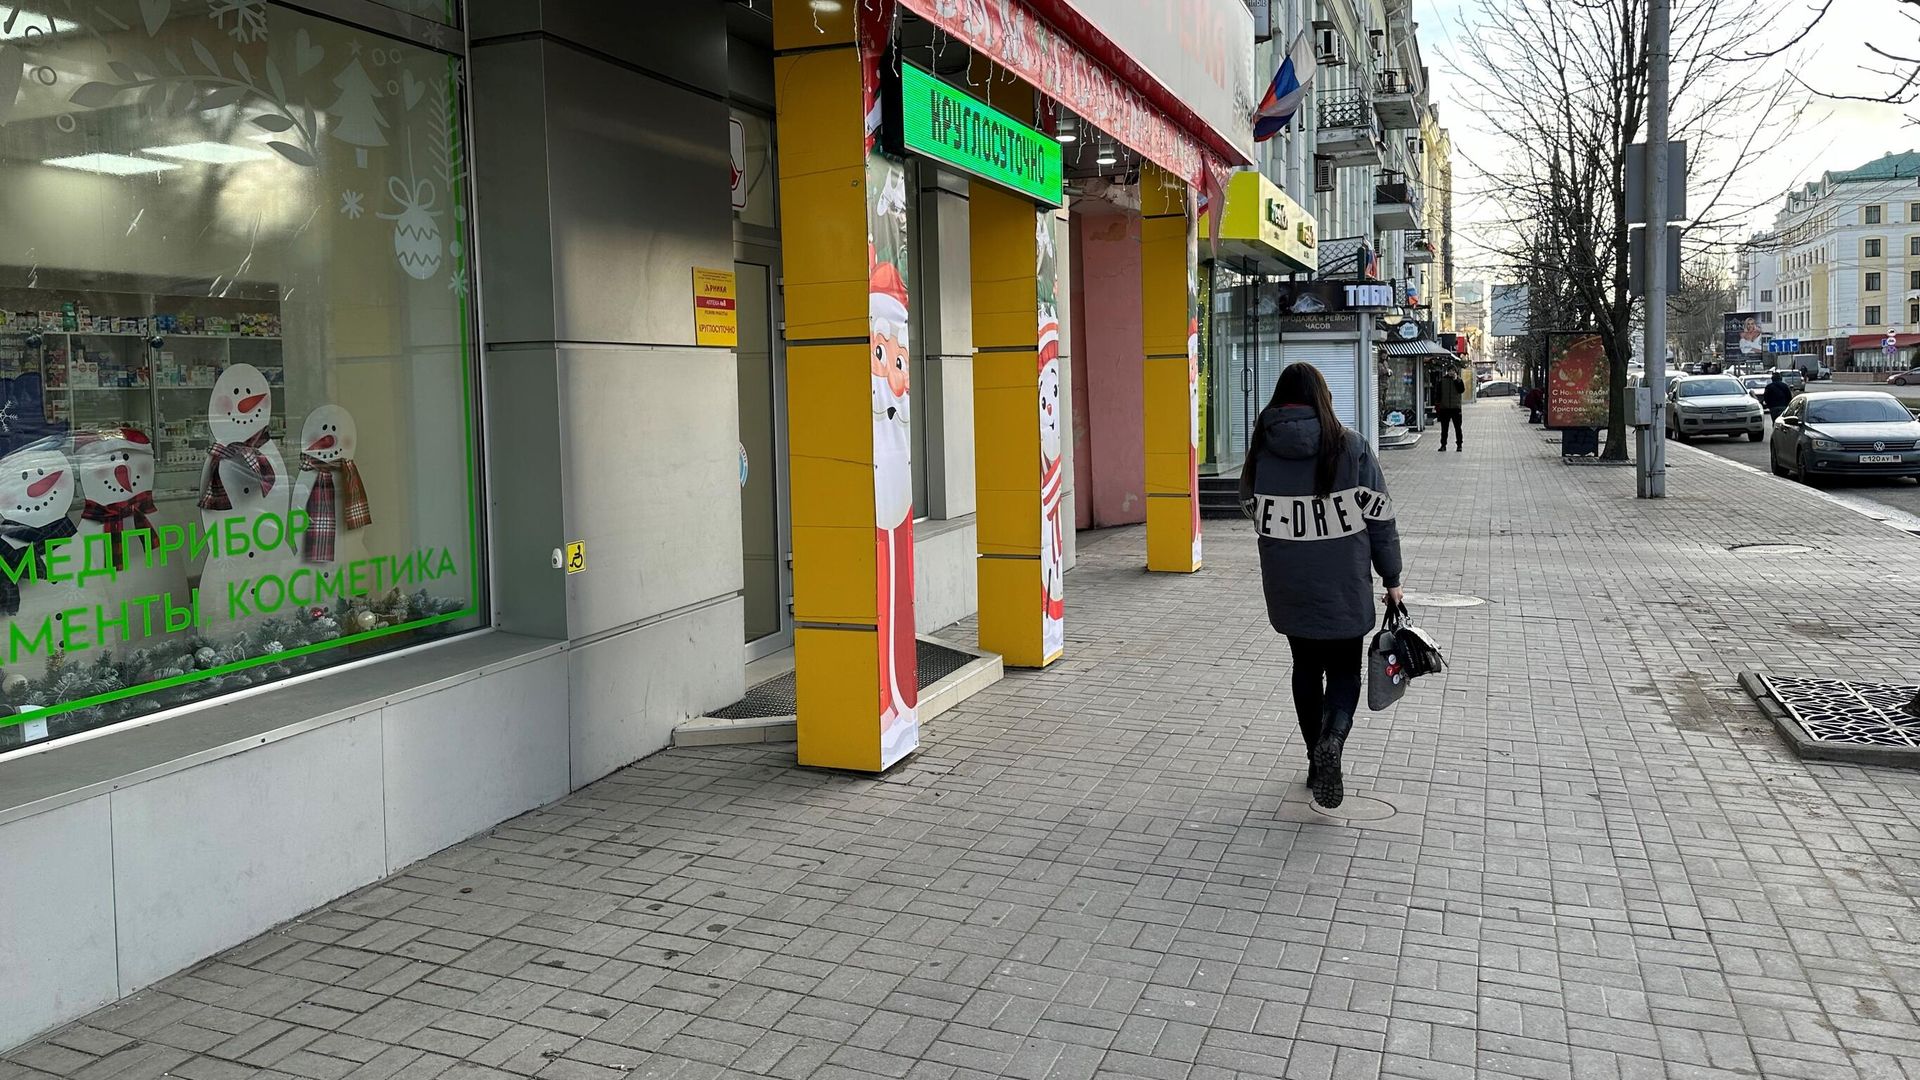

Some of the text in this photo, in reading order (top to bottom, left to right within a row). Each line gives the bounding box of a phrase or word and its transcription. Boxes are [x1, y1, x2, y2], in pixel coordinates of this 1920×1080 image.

[930, 88, 1045, 185] КРУГЛОСУТОЧНО
[699, 324, 735, 334] КРУГЛОСУТОЧНО
[1282, 314, 1317, 323] ПРОДАЖА
[1305, 322, 1331, 330] ЧАСОВ
[0, 509, 310, 588] МЕДПРИБОР
[0, 547, 457, 667] МЕНТЫ, КОСМЕТИКА
